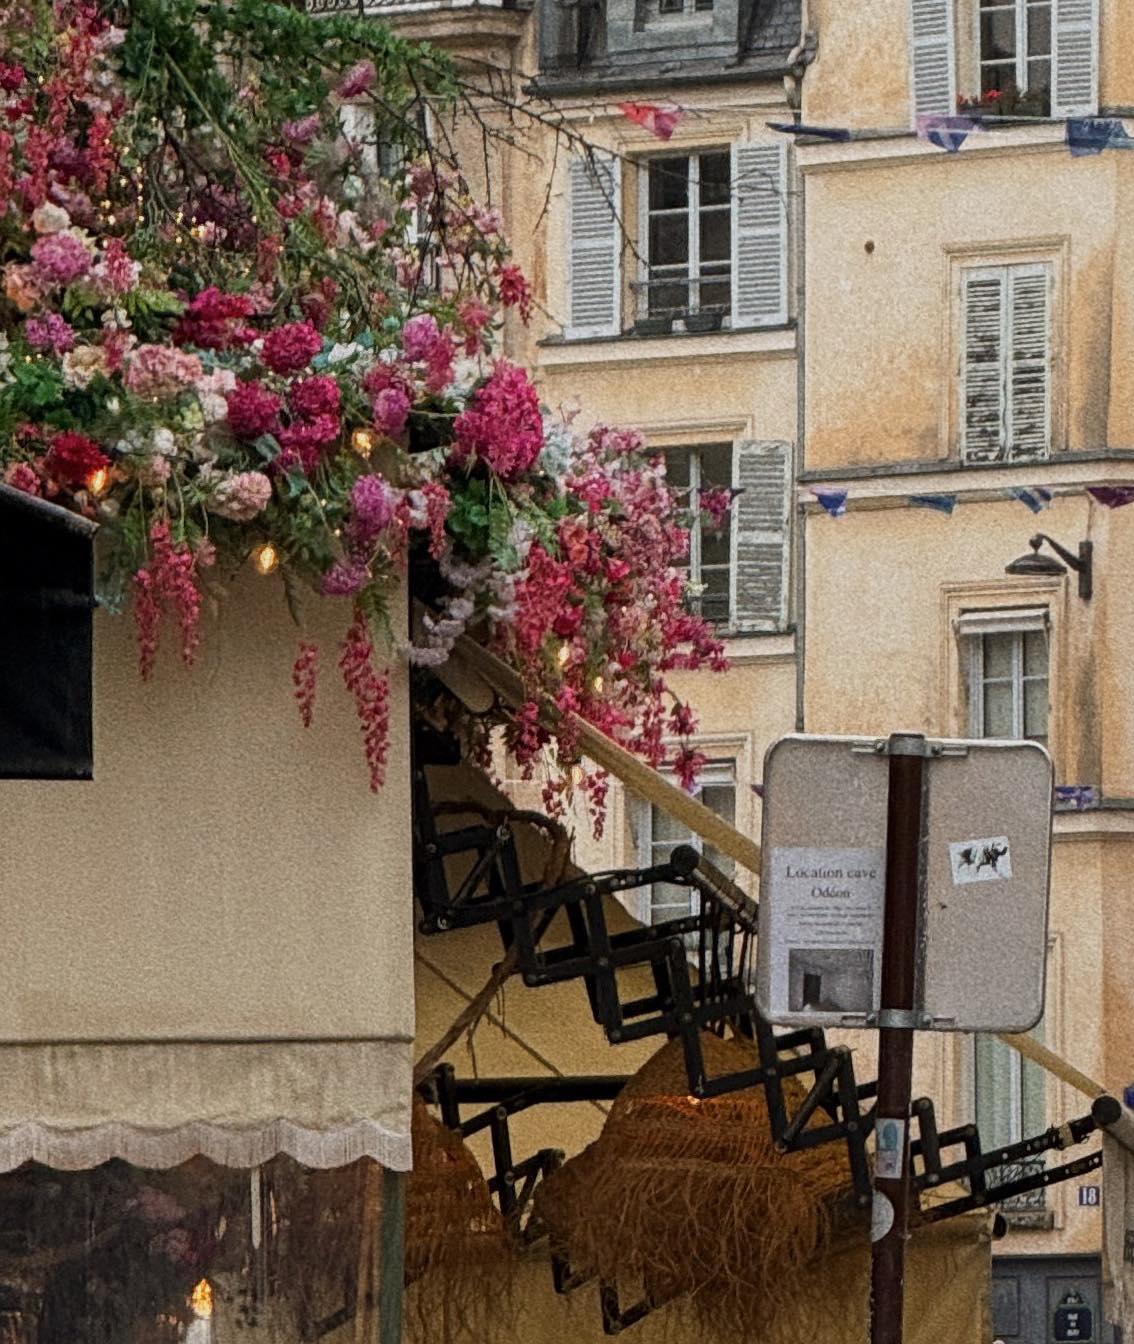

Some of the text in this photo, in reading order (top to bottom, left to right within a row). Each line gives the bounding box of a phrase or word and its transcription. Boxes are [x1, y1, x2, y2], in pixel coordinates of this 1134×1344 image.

[786, 865, 877, 878] Location cave
[1082, 1187, 1098, 1205] 18
